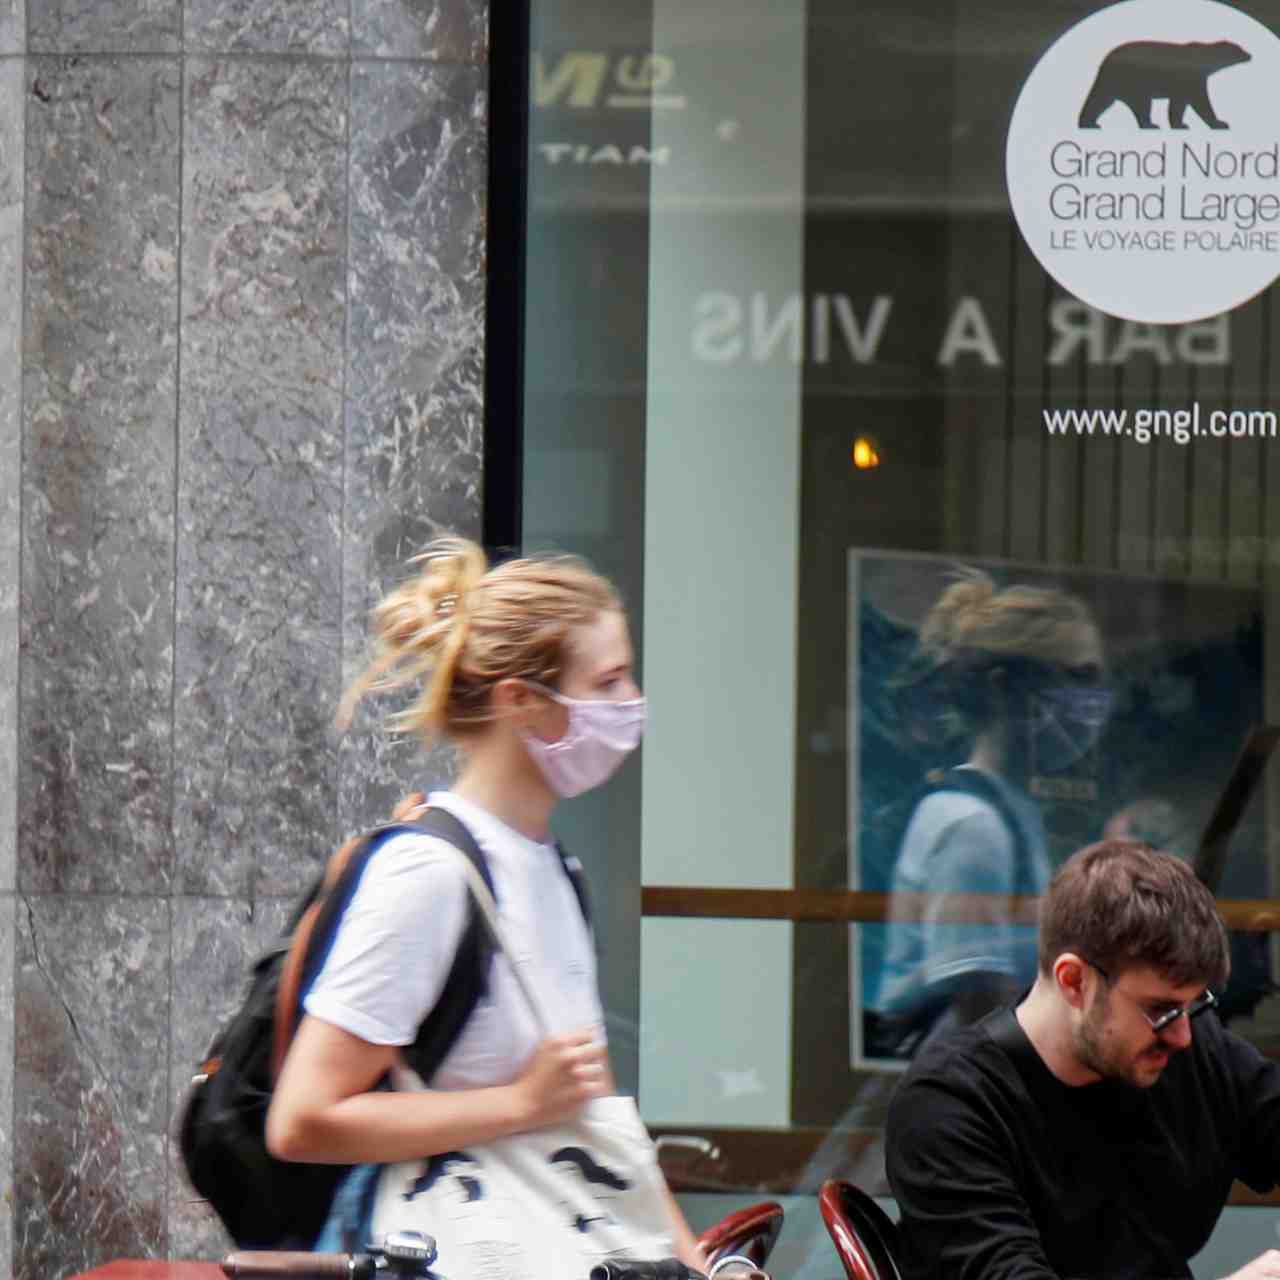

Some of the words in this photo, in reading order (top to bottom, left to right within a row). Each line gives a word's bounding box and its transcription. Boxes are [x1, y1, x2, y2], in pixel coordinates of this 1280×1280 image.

[1049, 139, 1166, 179] Grand
[1181, 140, 1280, 179] Nord
[1048, 182, 1166, 221] Grand
[1180, 184, 1280, 231] Large
[1049, 229, 1078, 251] LE
[1083, 229, 1177, 251] VOYAGE
[1182, 229, 1280, 251] POLAIRE
[1042, 401, 1278, 445] www.gngl.com
